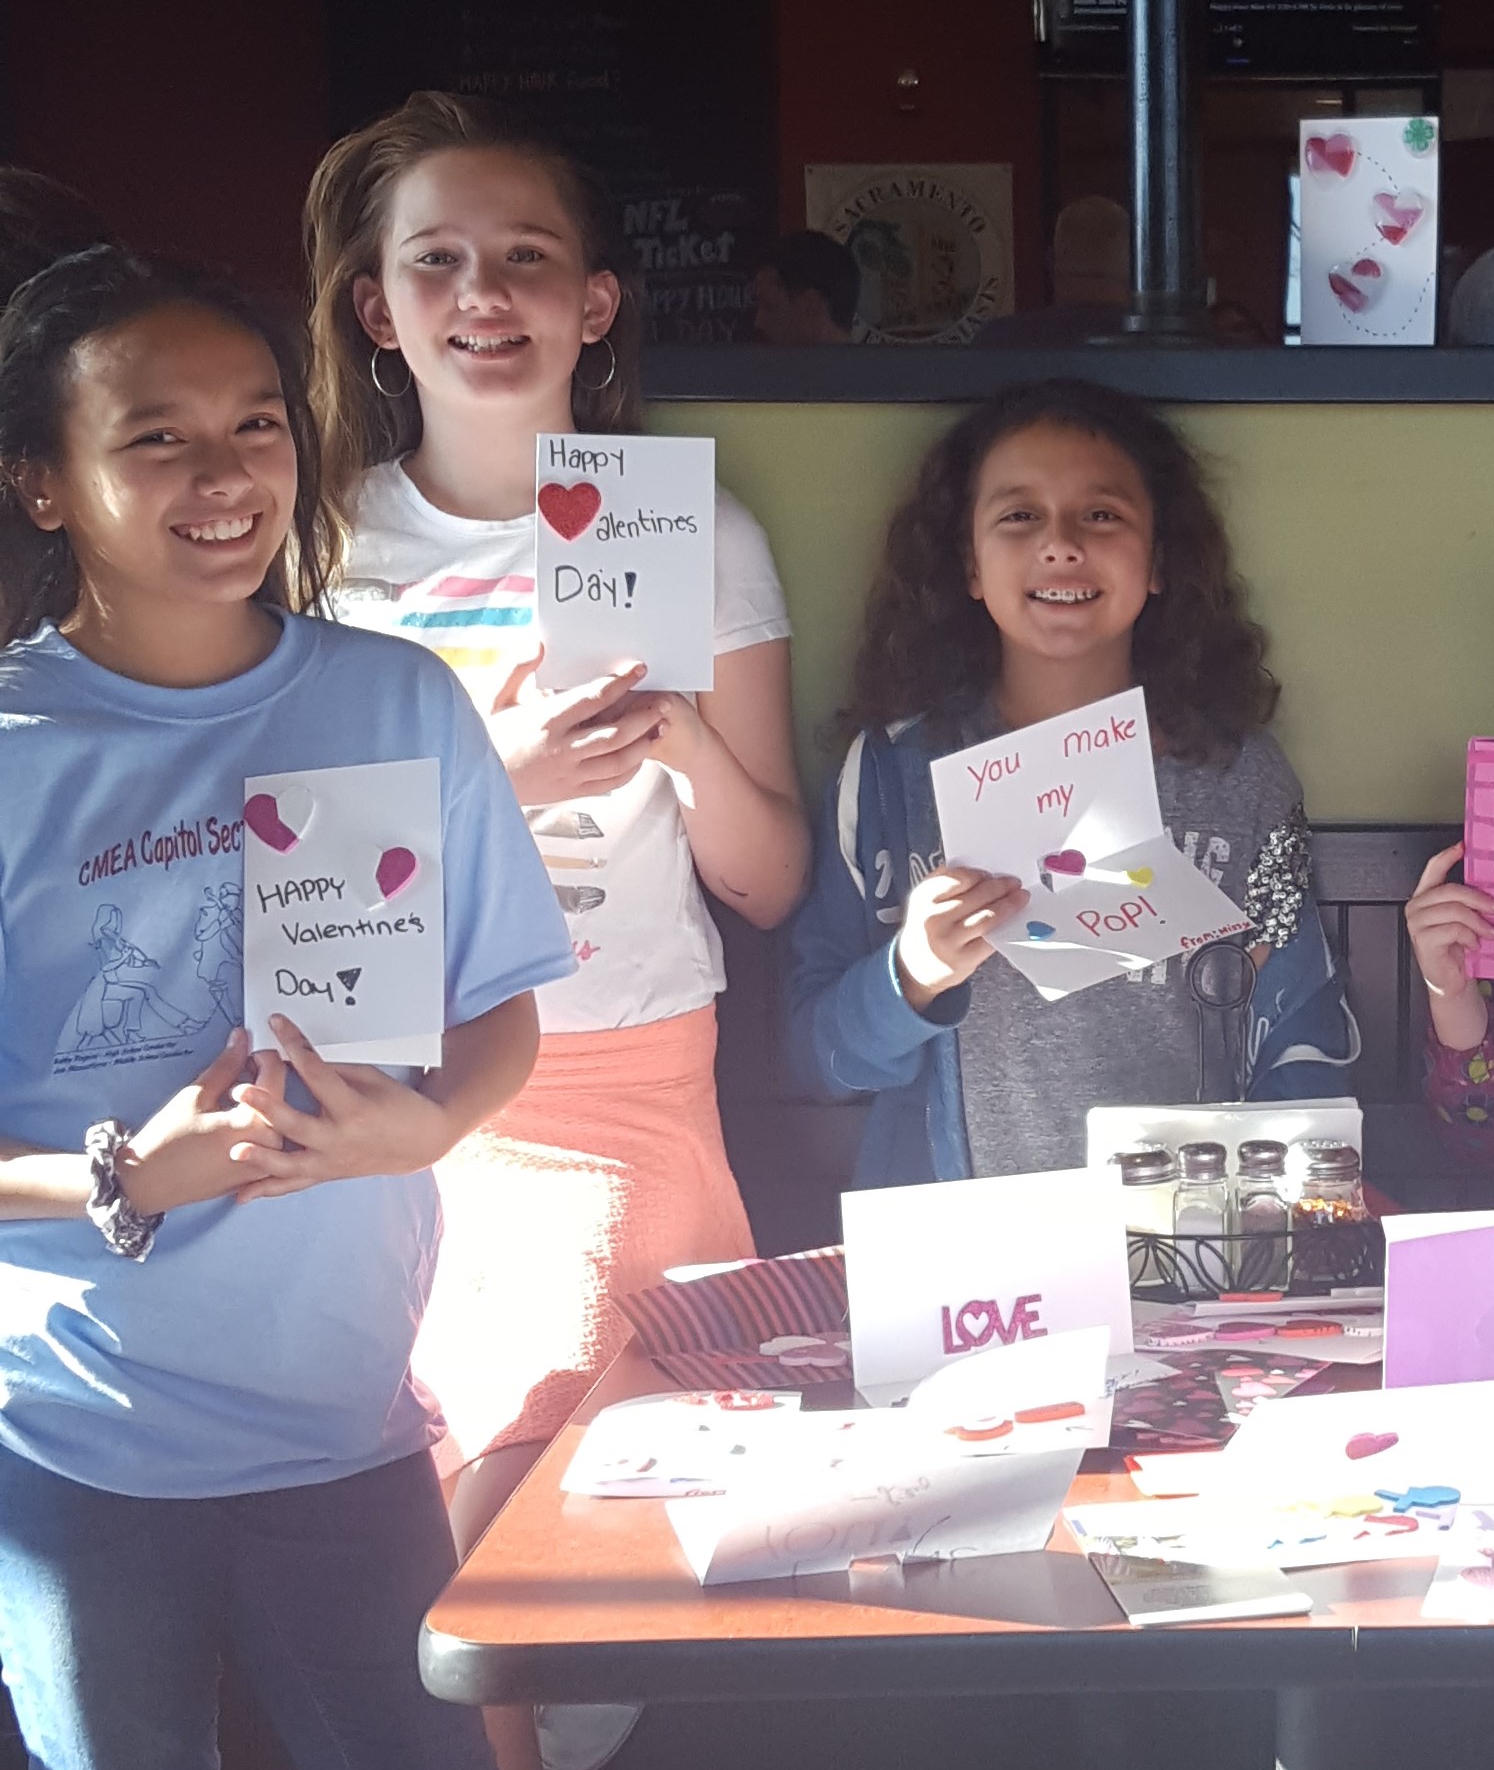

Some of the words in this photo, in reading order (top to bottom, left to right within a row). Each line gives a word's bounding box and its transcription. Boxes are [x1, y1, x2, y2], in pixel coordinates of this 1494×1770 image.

[623, 197, 689, 235] NFL
[835, 179, 987, 238] SACRAMENTO
[549, 437, 624, 477] Happy
[554, 564, 637, 609] Day!
[1063, 715, 1137, 758] make
[1036, 783, 1075, 818] my
[78, 837, 138, 887] CMEA
[140, 818, 204, 871] Capitol
[256, 876, 346, 914] HAPPY
[281, 911, 425, 946] Valentine's
[274, 966, 363, 1006] Day!
[941, 1293, 1049, 1355] LOVE
